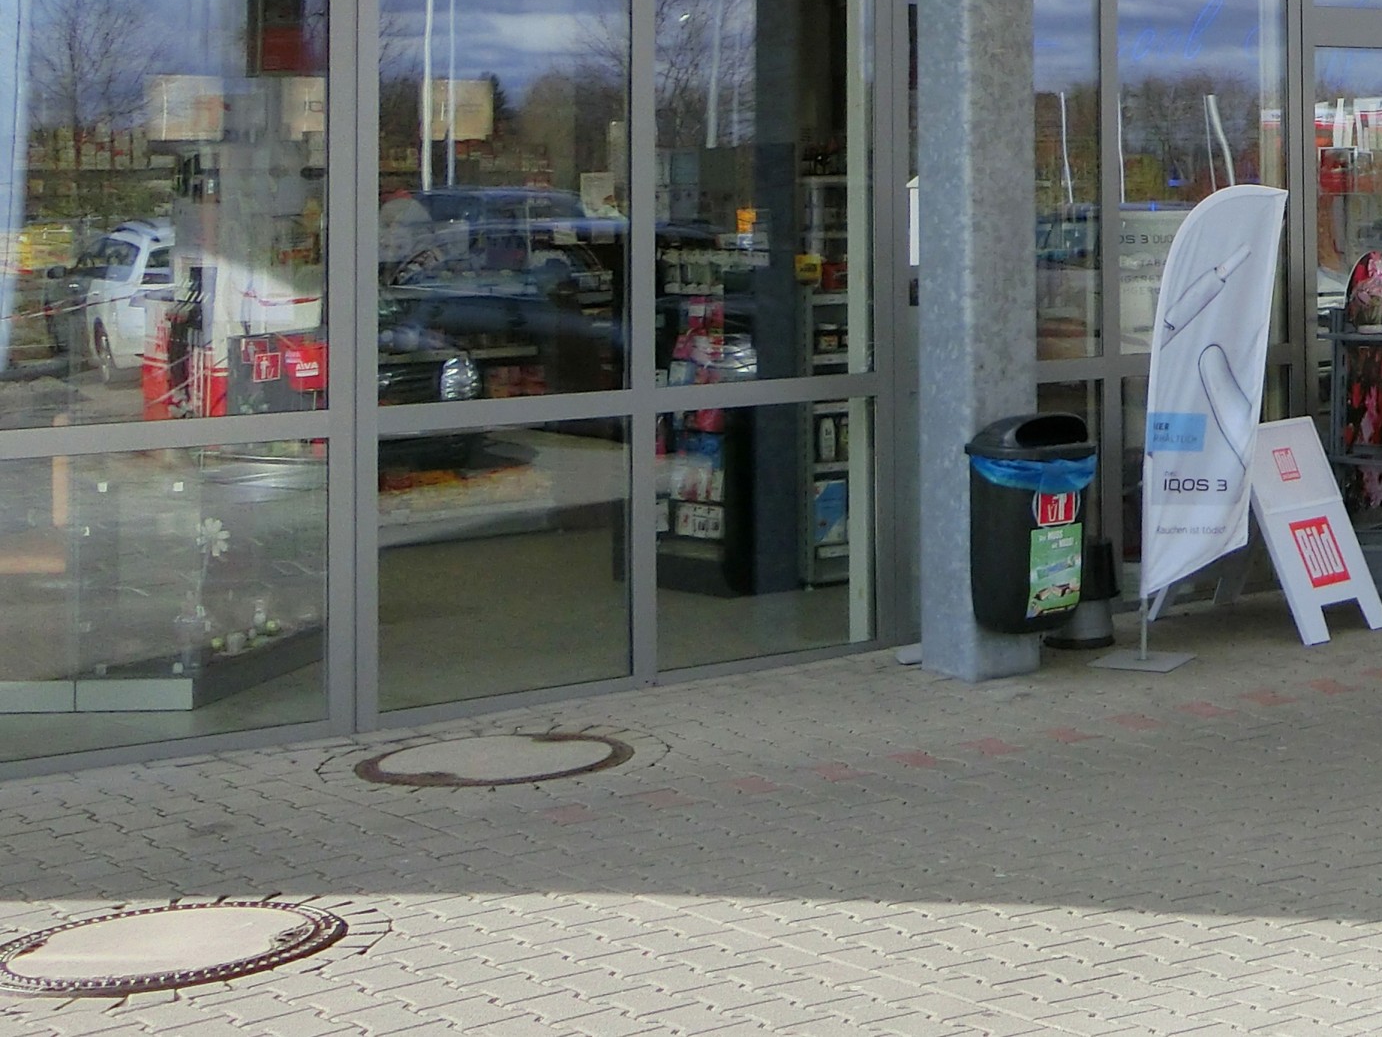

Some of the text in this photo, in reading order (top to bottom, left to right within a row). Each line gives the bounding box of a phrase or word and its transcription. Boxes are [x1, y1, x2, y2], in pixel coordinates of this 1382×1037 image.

[1140, 234, 1149, 244] 3
[1163, 478, 1228, 494] IQOS 3
[1295, 524, 1344, 578] Bild
